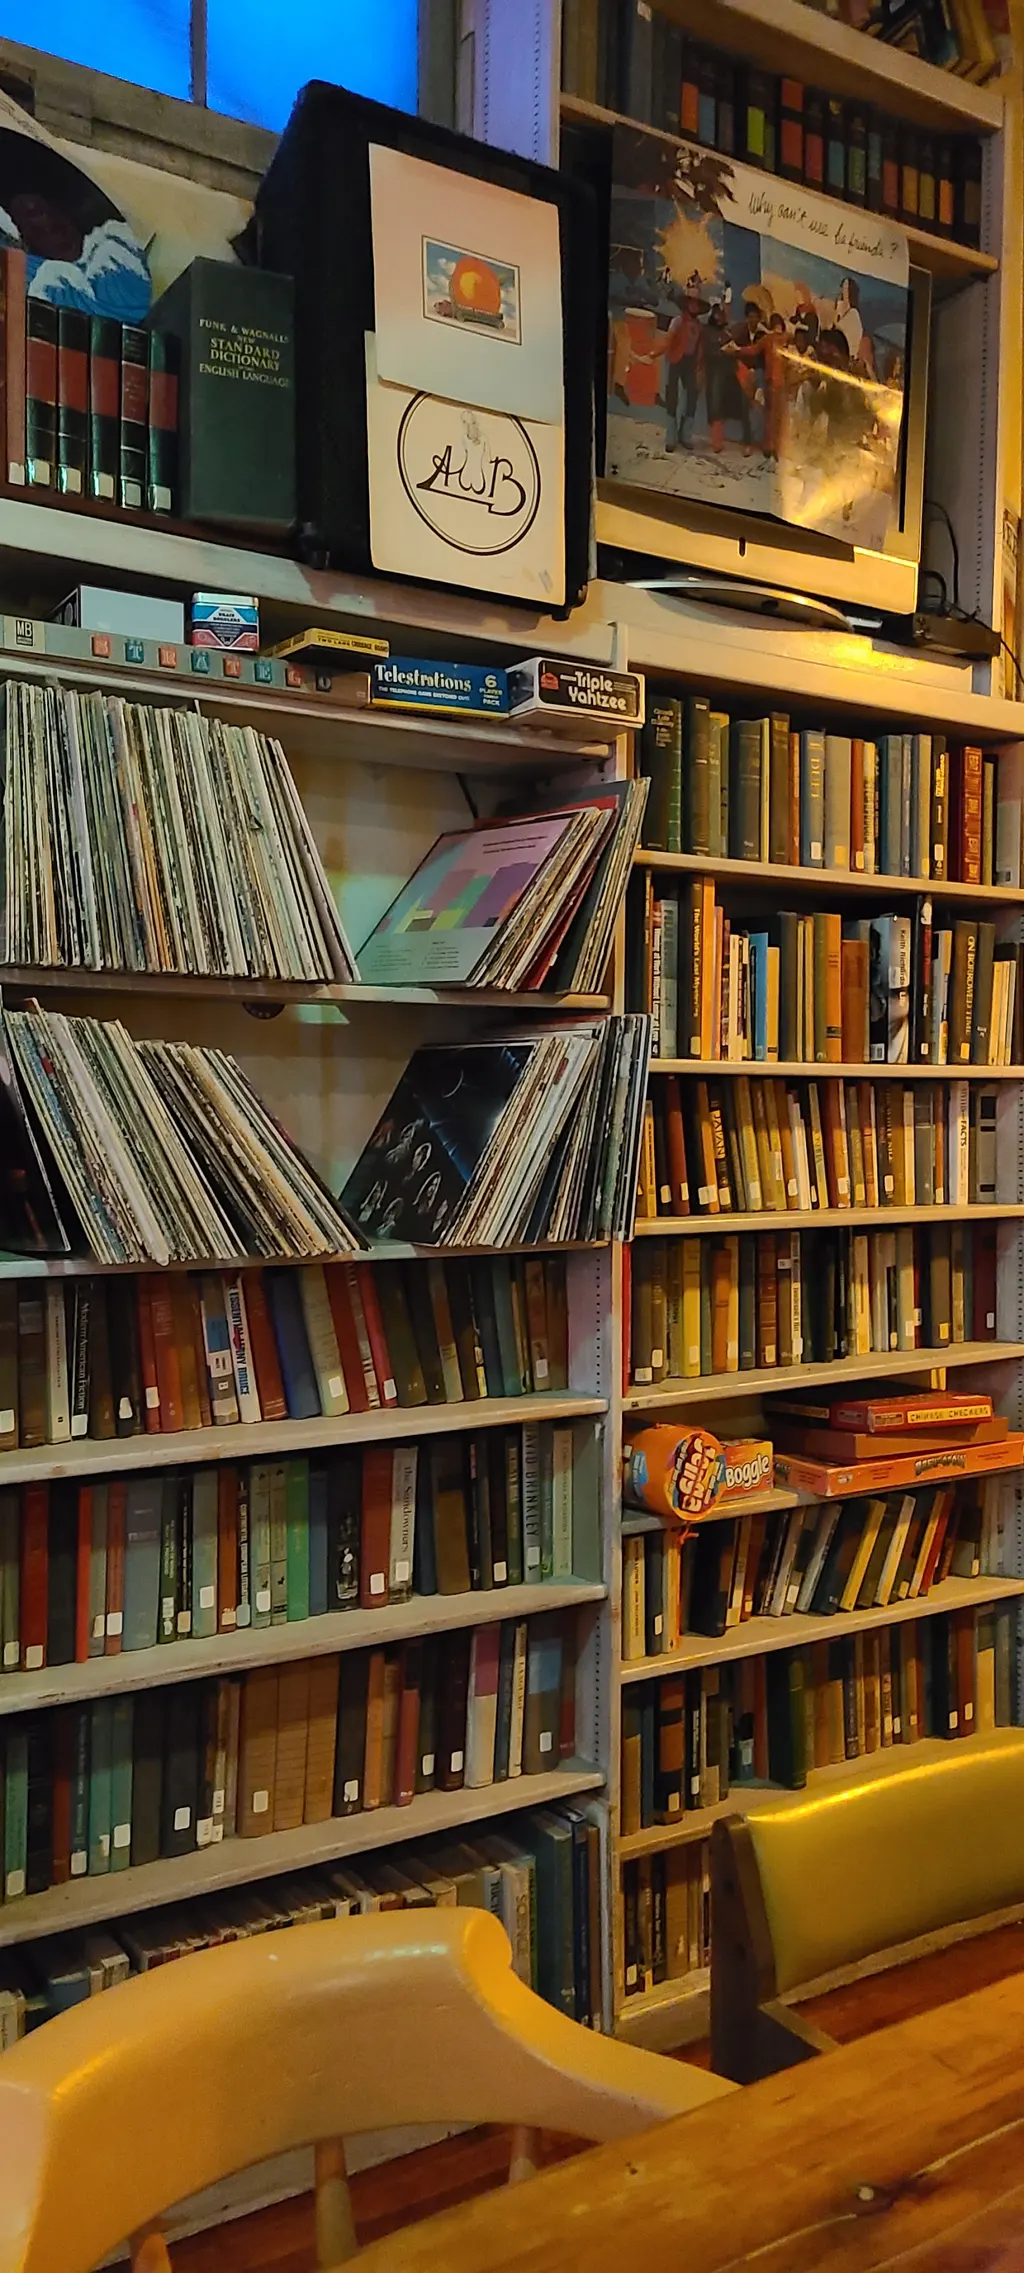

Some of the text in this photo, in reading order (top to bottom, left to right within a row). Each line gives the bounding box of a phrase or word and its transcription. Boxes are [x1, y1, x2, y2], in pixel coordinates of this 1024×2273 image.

[748, 192, 773, 227] Why
[777, 203, 807, 229] can't
[809, 218, 828, 237] we
[834, 222, 846, 245] be
[199, 318, 288, 343] FUNK & WAGNALLS
[210, 338, 280, 360] STANDARD
[210, 349, 280, 371] DICTIONARY
[199, 363, 289, 388] ENGLISH LANGUAGE
[16, 620, 33, 638] MB
[351, 640, 371, 649] CRIBBAGE
[374, 664, 472, 692] Telestrations
[484, 675, 497, 689] 6
[575, 671, 613, 692] Triple
[389, 687, 417, 696] TELEPHONE
[417, 690, 432, 698] GAME
[432, 692, 457, 700] SKETCHED
[479, 688, 502, 696] PLAYER
[482, 698, 501, 706] PACK
[568, 686, 627, 711] Yahtzee
[693, 908, 701, 924] The
[693, 924, 701, 956] World's
[967, 936, 975, 952] ON
[693, 957, 701, 976] Last
[965, 953, 975, 1008] BORROWED
[77, 1303, 88, 1410] Modern American Fiction
[238, 1367, 249, 1395] BRUCE
[948, 1406, 989, 1418] CHECKERS
[679, 1437, 716, 1513] Jenga
[725, 1453, 770, 1489] Boggle
[401, 1466, 413, 1553] the Sundowners
[525, 1471, 538, 1537] BRINKLEY
